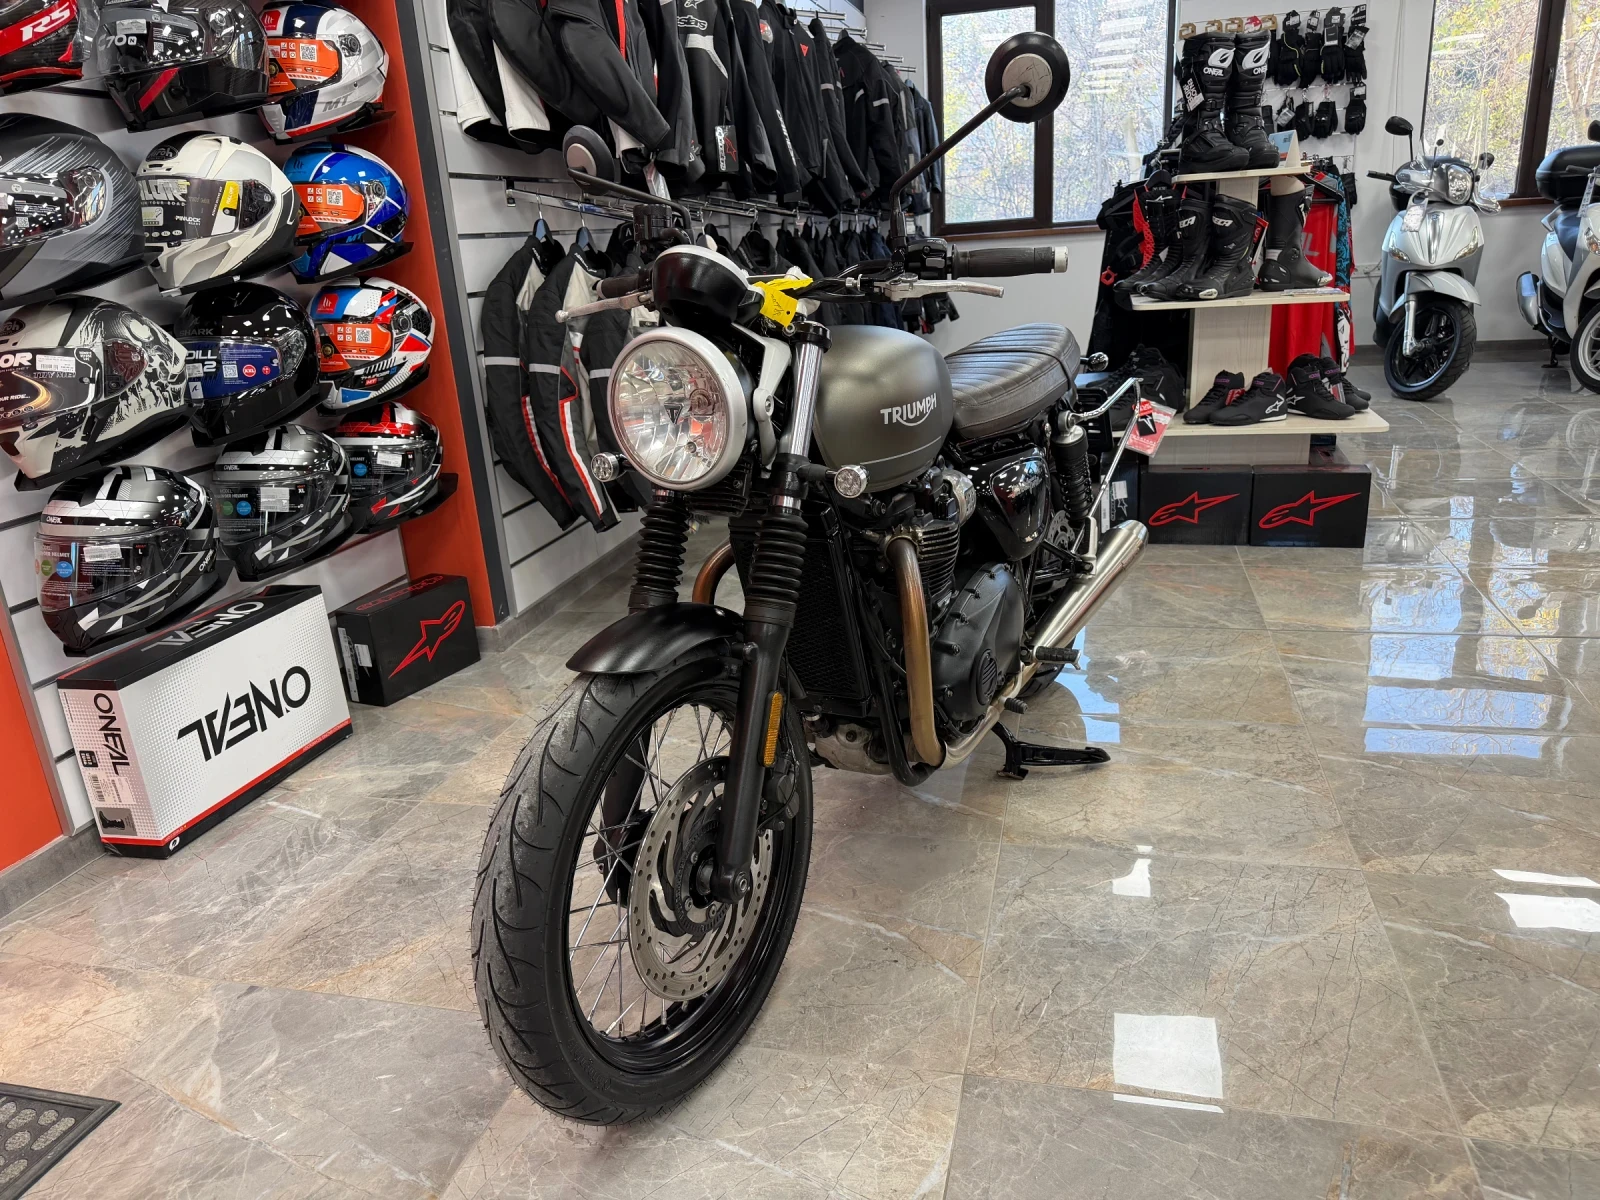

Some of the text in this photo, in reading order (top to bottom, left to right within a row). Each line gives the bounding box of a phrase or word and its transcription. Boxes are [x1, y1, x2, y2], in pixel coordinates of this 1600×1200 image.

[20, 2, 71, 42] RS
[180, 328, 214, 336] SHARK
[203, 361, 217, 373] 2
[880, 392, 937, 426] TRIUMPH
